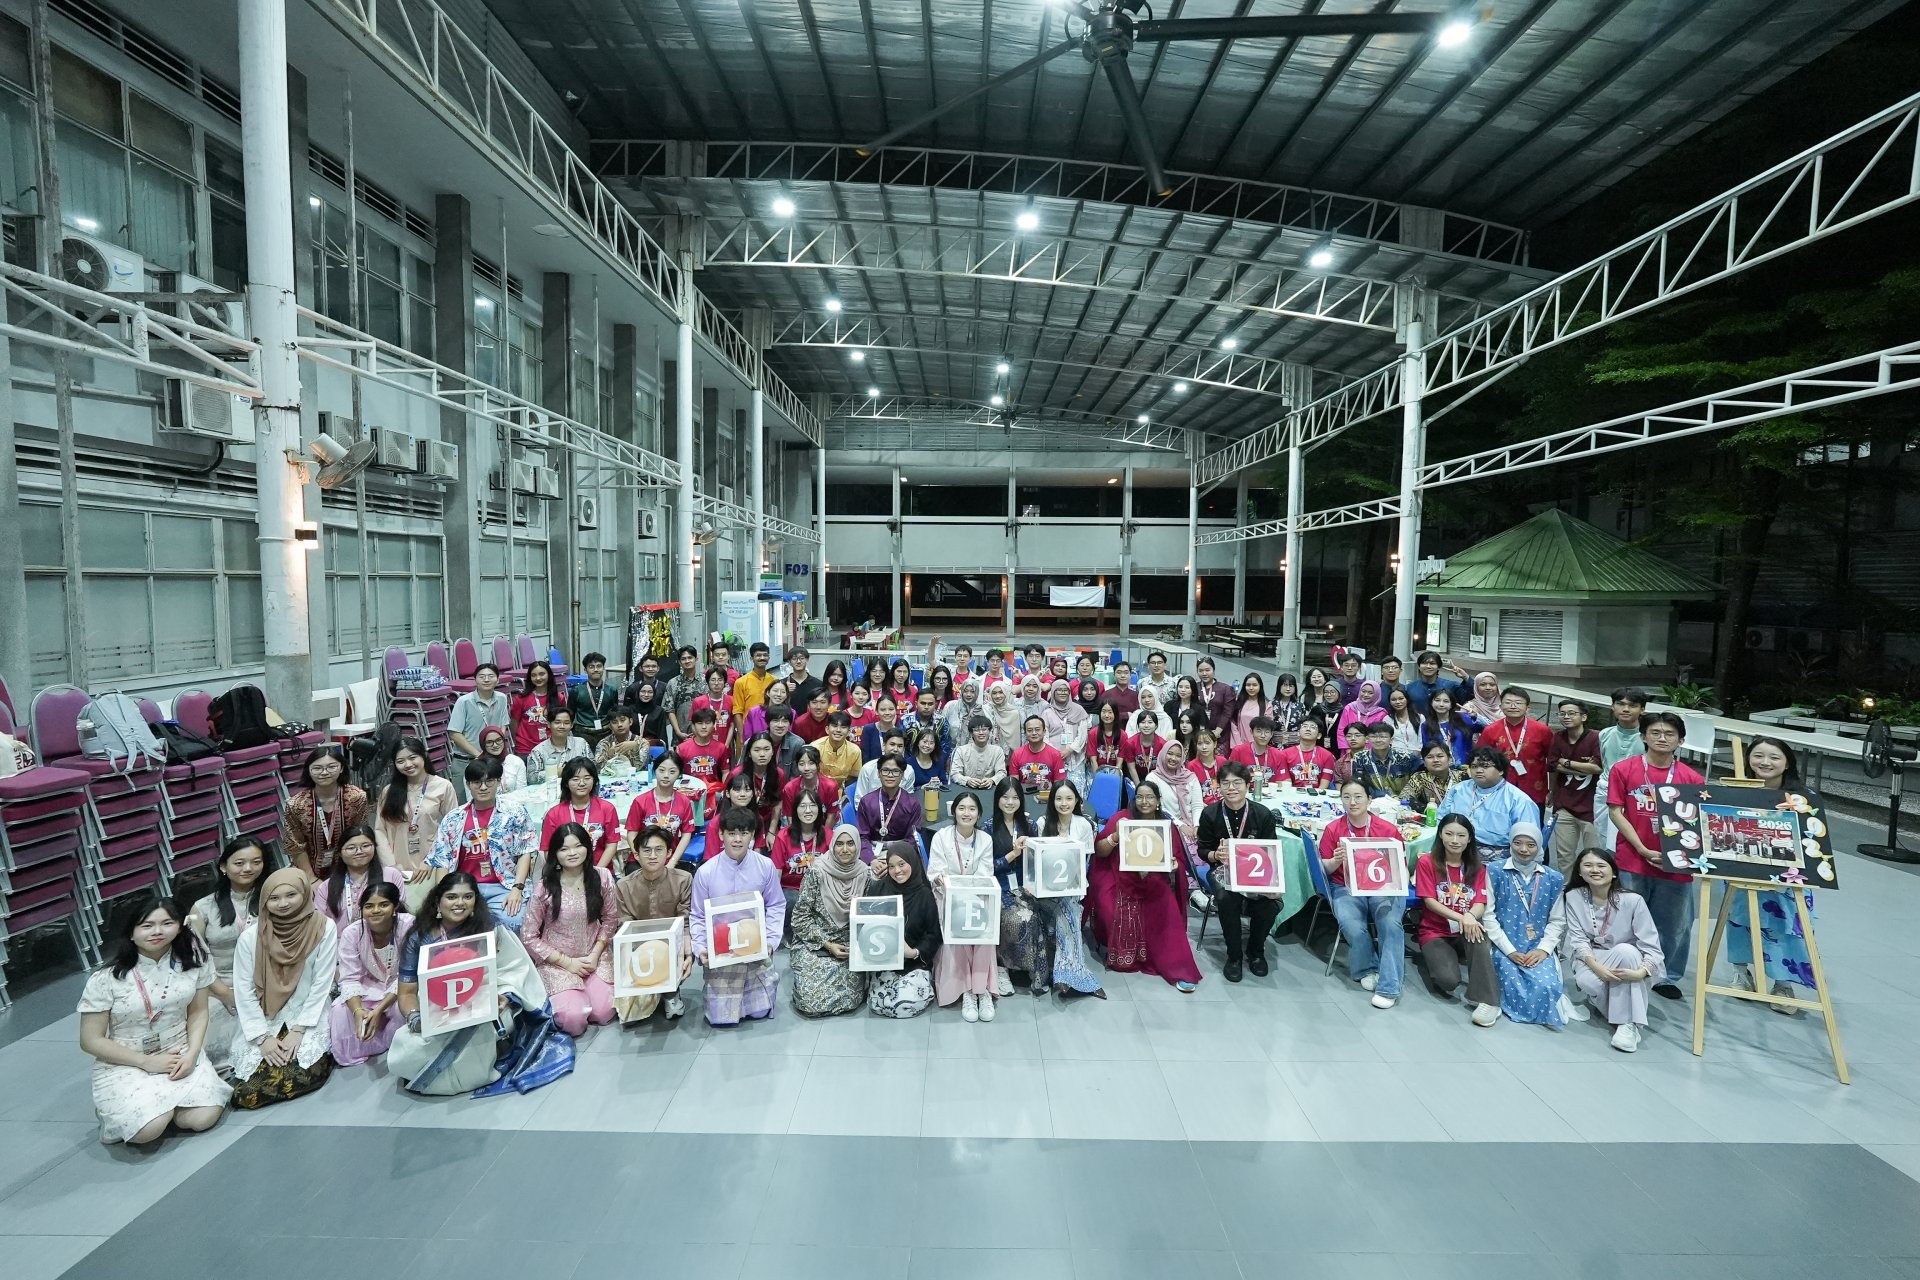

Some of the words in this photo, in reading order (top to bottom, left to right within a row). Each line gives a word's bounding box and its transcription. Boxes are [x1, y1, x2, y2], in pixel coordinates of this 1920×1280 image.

[1053, 859, 1069, 883] 2
[1247, 852, 1265, 877] 2
[1367, 860, 1386, 882] 6
[962, 900, 986, 931] E
[728, 921, 749, 949] L
[869, 932, 886, 956] S
[631, 948, 656, 977] U
[442, 976, 474, 1011] P
